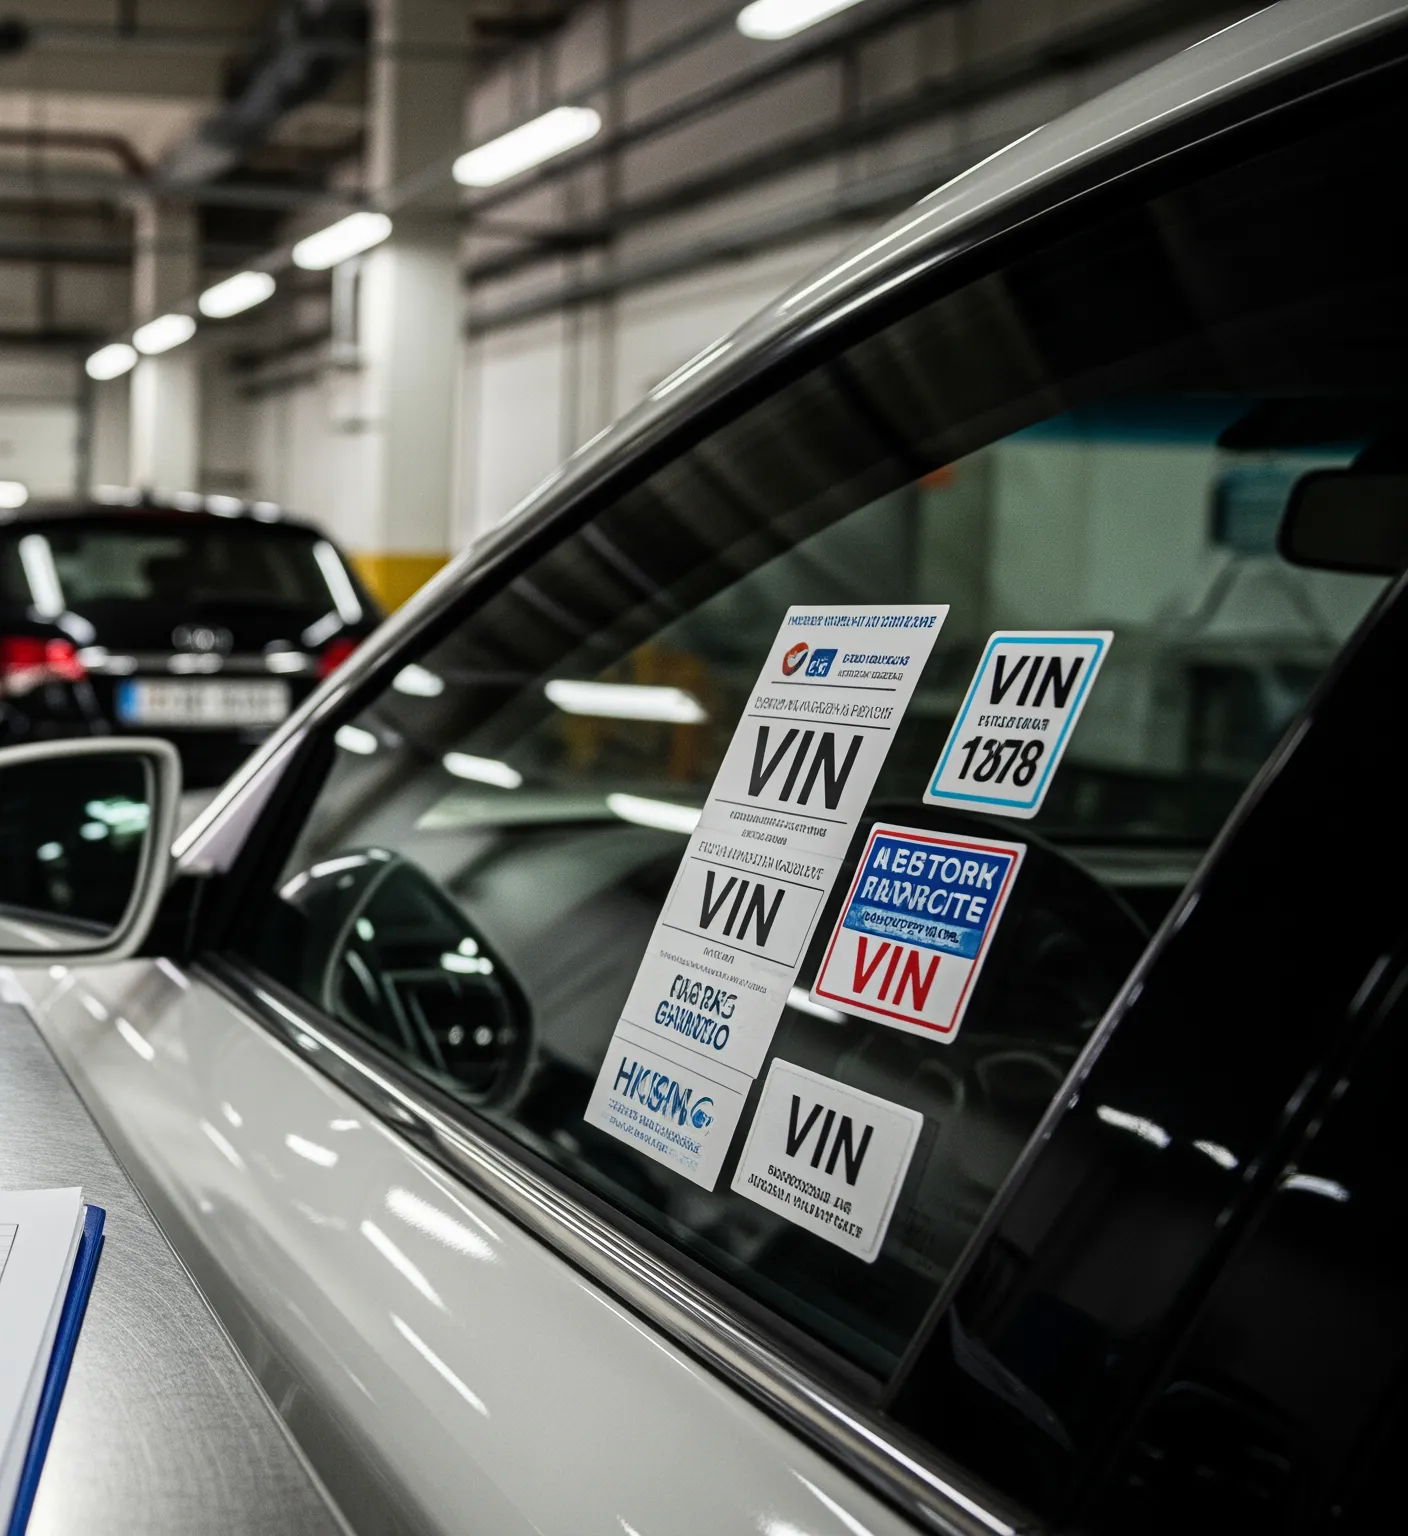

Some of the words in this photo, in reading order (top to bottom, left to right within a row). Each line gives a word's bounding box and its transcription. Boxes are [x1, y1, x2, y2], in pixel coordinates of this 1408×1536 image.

[990, 655, 1084, 708] VIN
[748, 726, 864, 810] VIN
[699, 870, 786, 947] VIN
[852, 936, 941, 1012] VIN
[786, 1094, 874, 1186] VIN
